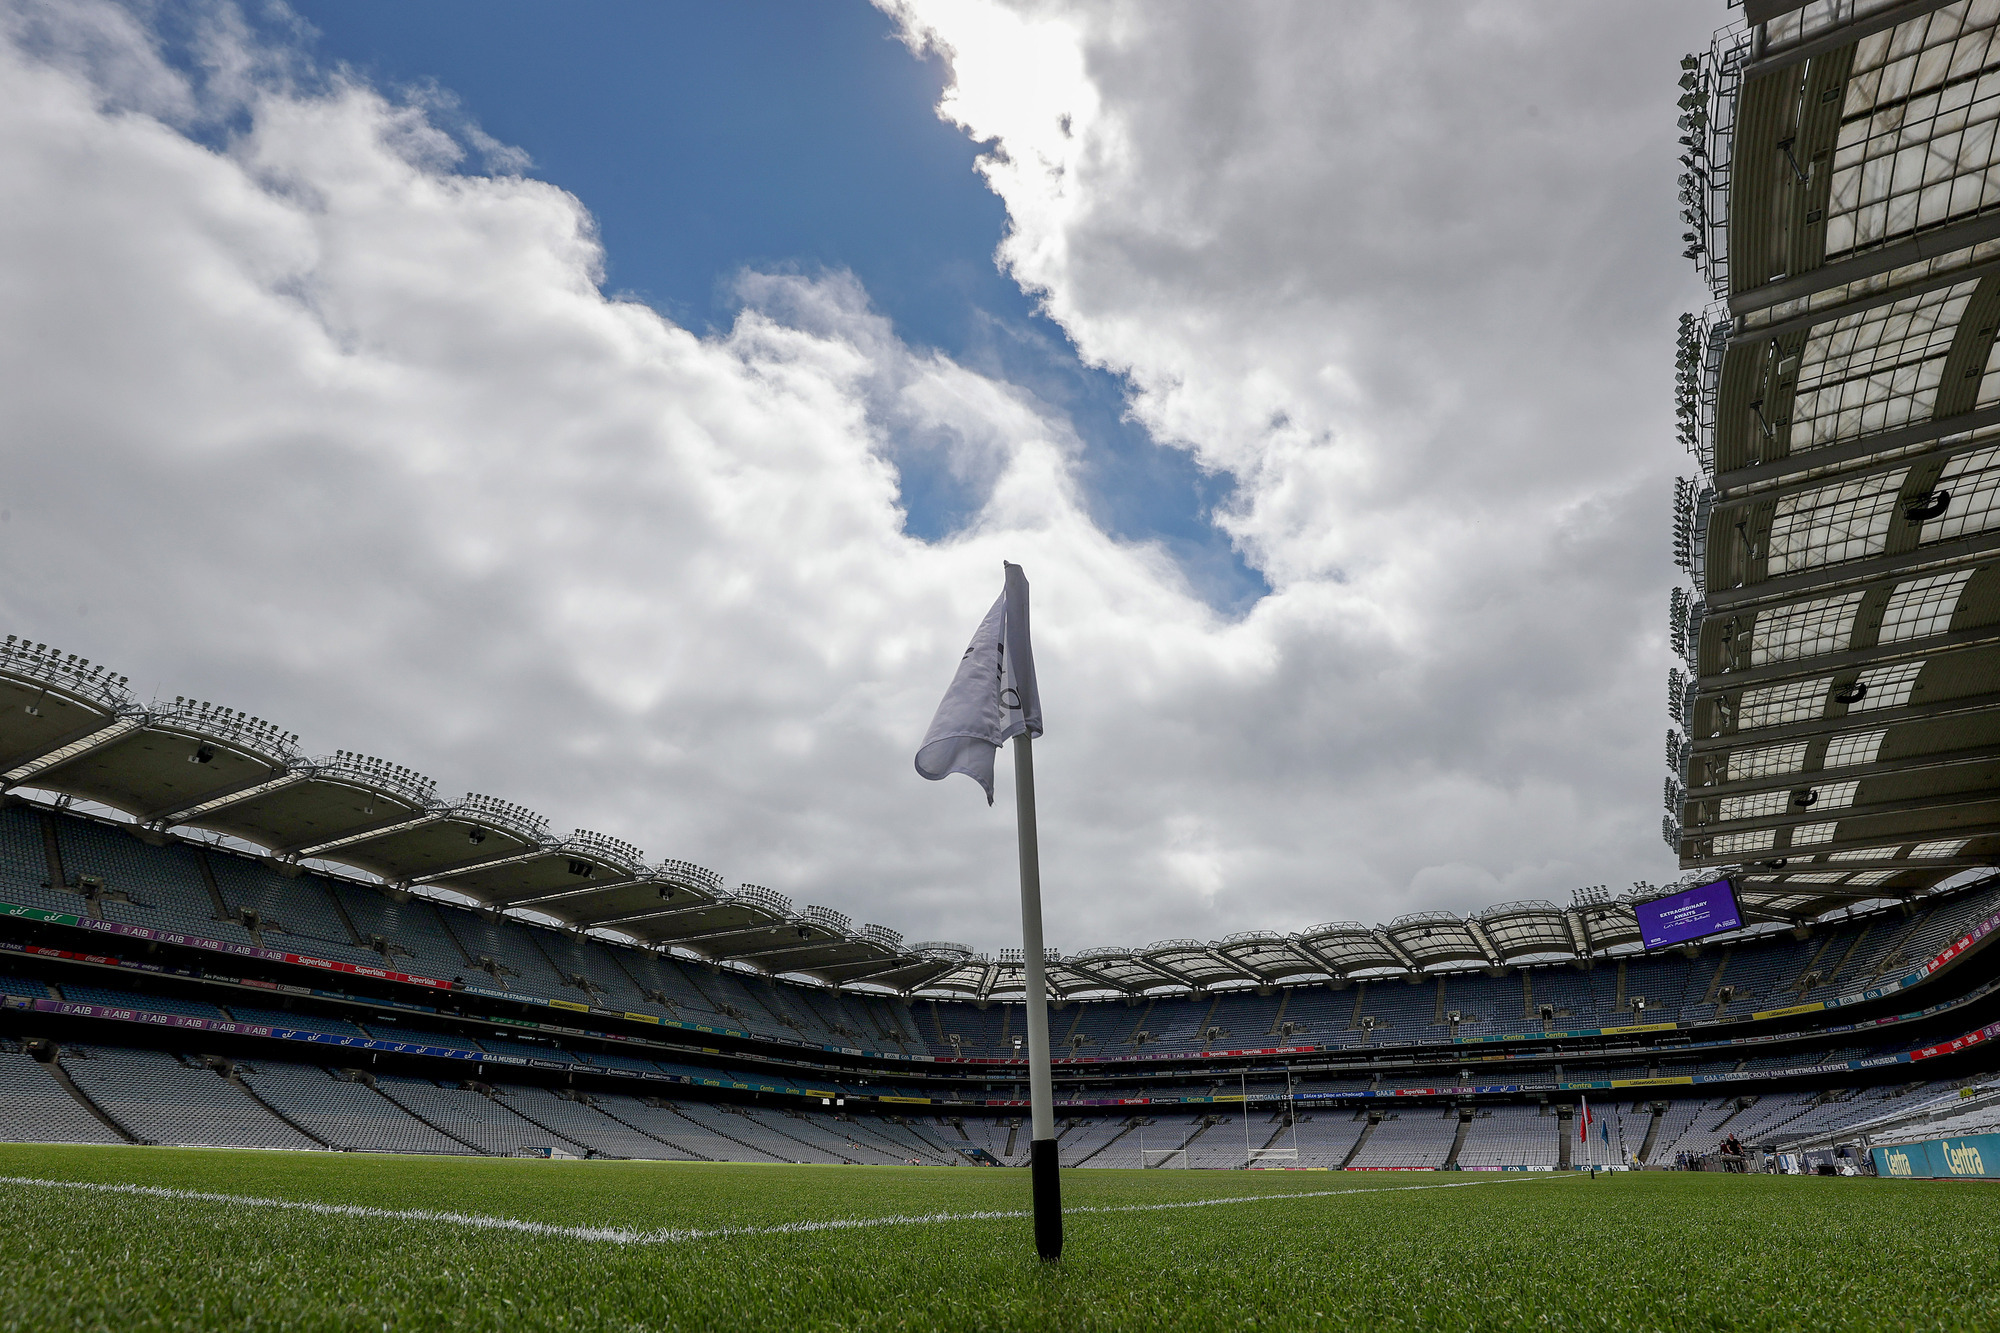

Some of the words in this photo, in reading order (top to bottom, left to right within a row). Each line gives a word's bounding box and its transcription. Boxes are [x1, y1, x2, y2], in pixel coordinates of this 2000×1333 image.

[1659, 901, 1708, 918] EXTRAORDINARY
[1673, 910, 1696, 920] AWAITS
[92, 921, 112, 931] AIB
[130, 928, 149, 938] AIB
[167, 934, 185, 944] AIB
[201, 940, 218, 949] AIB
[234, 946, 251, 955] AIB
[266, 951, 282, 960] AIB
[298, 956, 332, 968] SuperValu
[354, 966, 387, 978] SuperValu
[407, 975, 437, 986] SuperValu
[478, 988, 503, 998] MUSEUM
[508, 993, 533, 1002] STADIUM
[533, 997, 549, 1005] TOUR
[72, 1007, 92, 1015] AIB
[111, 1011, 131, 1019] AIB
[149, 1015, 167, 1024] AIB
[184, 1019, 202, 1027] AIB
[664, 1019, 683, 1028] Centra
[219, 1023, 236, 1031] AIB
[251, 1027, 268, 1035] AIB
[696, 1024, 713, 1033] Centra
[725, 1029, 742, 1037] Centra
[482, 1054, 498, 1062] GAA
[498, 1055, 527, 1065] MUSEUM
[1860, 1058, 1874, 1068] GAA
[1874, 1056, 1898, 1066] MUSEUM
[1749, 1071, 1771, 1079] CROKE
[1771, 1070, 1785, 1078] PARK
[1785, 1066, 1817, 1076] MEETINGS
[1823, 1063, 1849, 1072] EVENTS
[703, 1078, 720, 1087] Centra
[1703, 1074, 1726, 1082] GAA.ie
[732, 1081, 749, 1090] Centra
[759, 1085, 775, 1093] Centra
[785, 1087, 800, 1095] Centra
[1403, 1088, 1427, 1096] SuperValu
[1884, 1148, 1913, 1176] Centra
[1942, 1141, 1985, 1175] Centra
